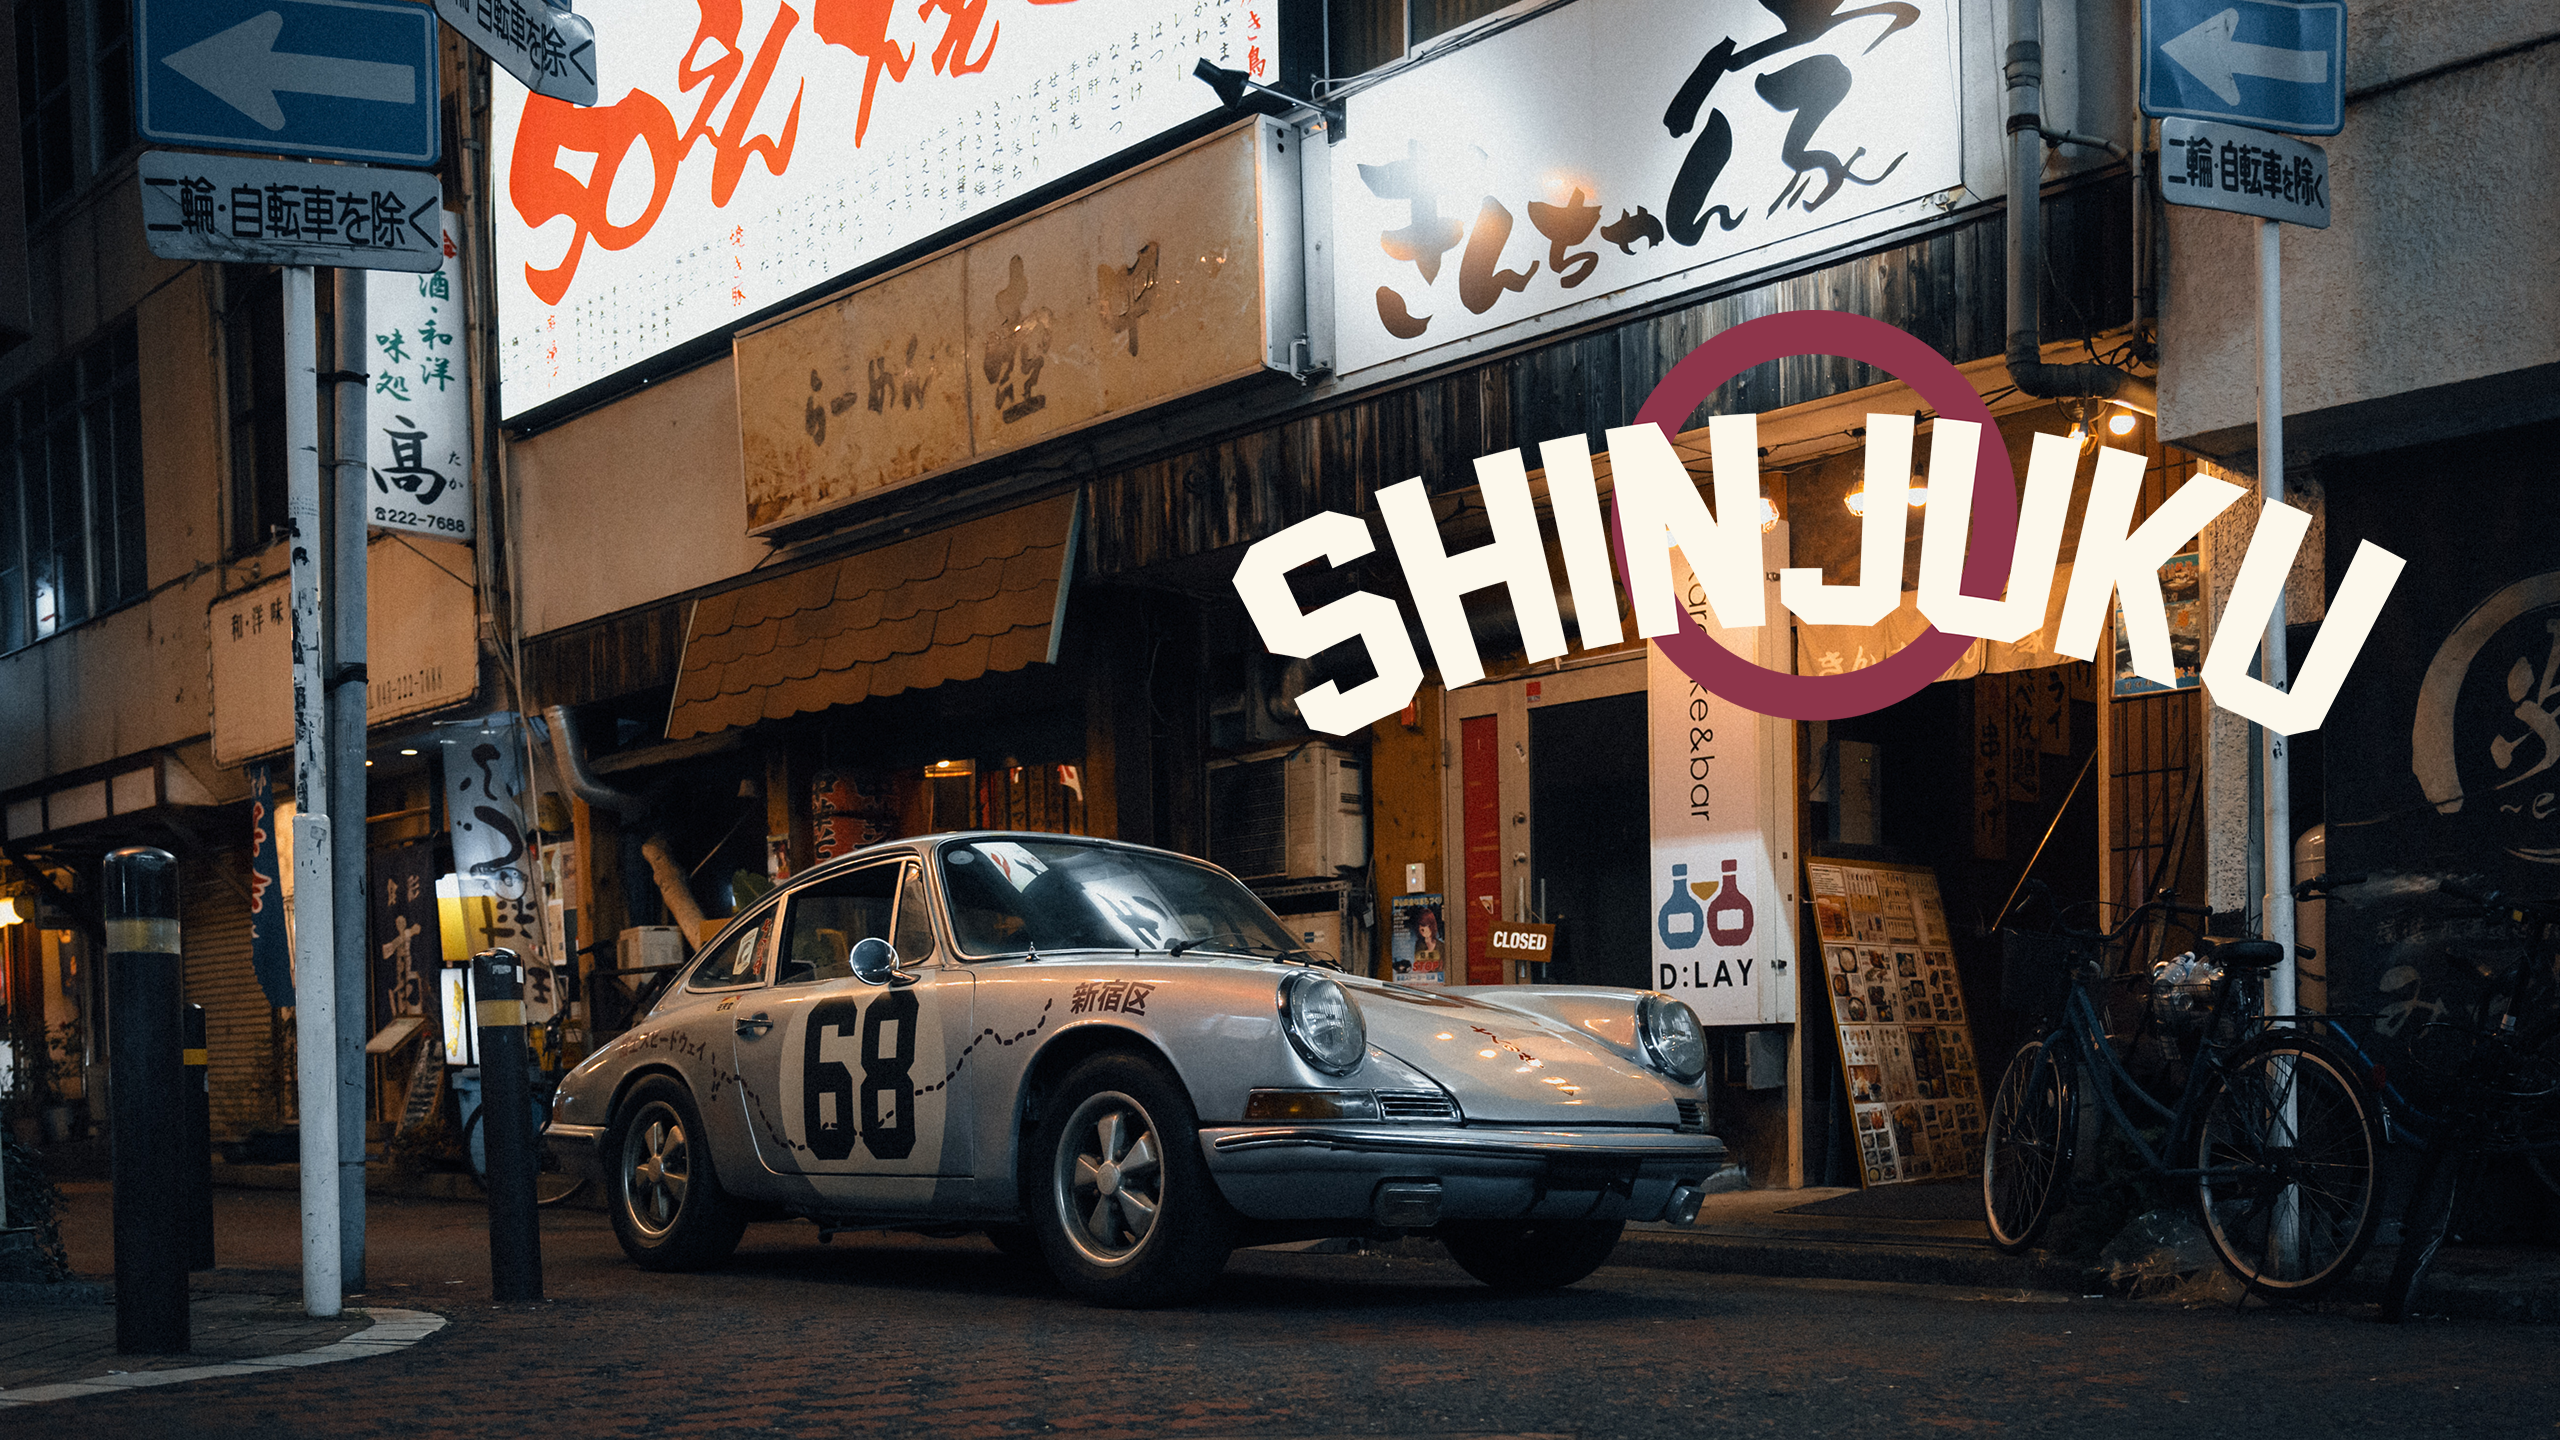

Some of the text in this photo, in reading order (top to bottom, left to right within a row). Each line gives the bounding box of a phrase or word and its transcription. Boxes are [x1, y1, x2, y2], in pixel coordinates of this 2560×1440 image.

[456, 0, 596, 86] 自転車を除く
[1216, 0, 1231, 62] ぎま
[1240, 0, 1266, 78] き鳥
[1048, 71, 1060, 141] せせり
[1066, 60, 1083, 132] 手羽先
[1108, 43, 1124, 135] なんこつ
[143, 175, 440, 249] 二輪・自転車を除く
[375, 327, 412, 402] 味処
[1492, 930, 1548, 951] CLOSED
[1660, 959, 1754, 989] D:LAY
[1070, 979, 1156, 1017] 新宿区
[803, 989, 920, 1161] 68
